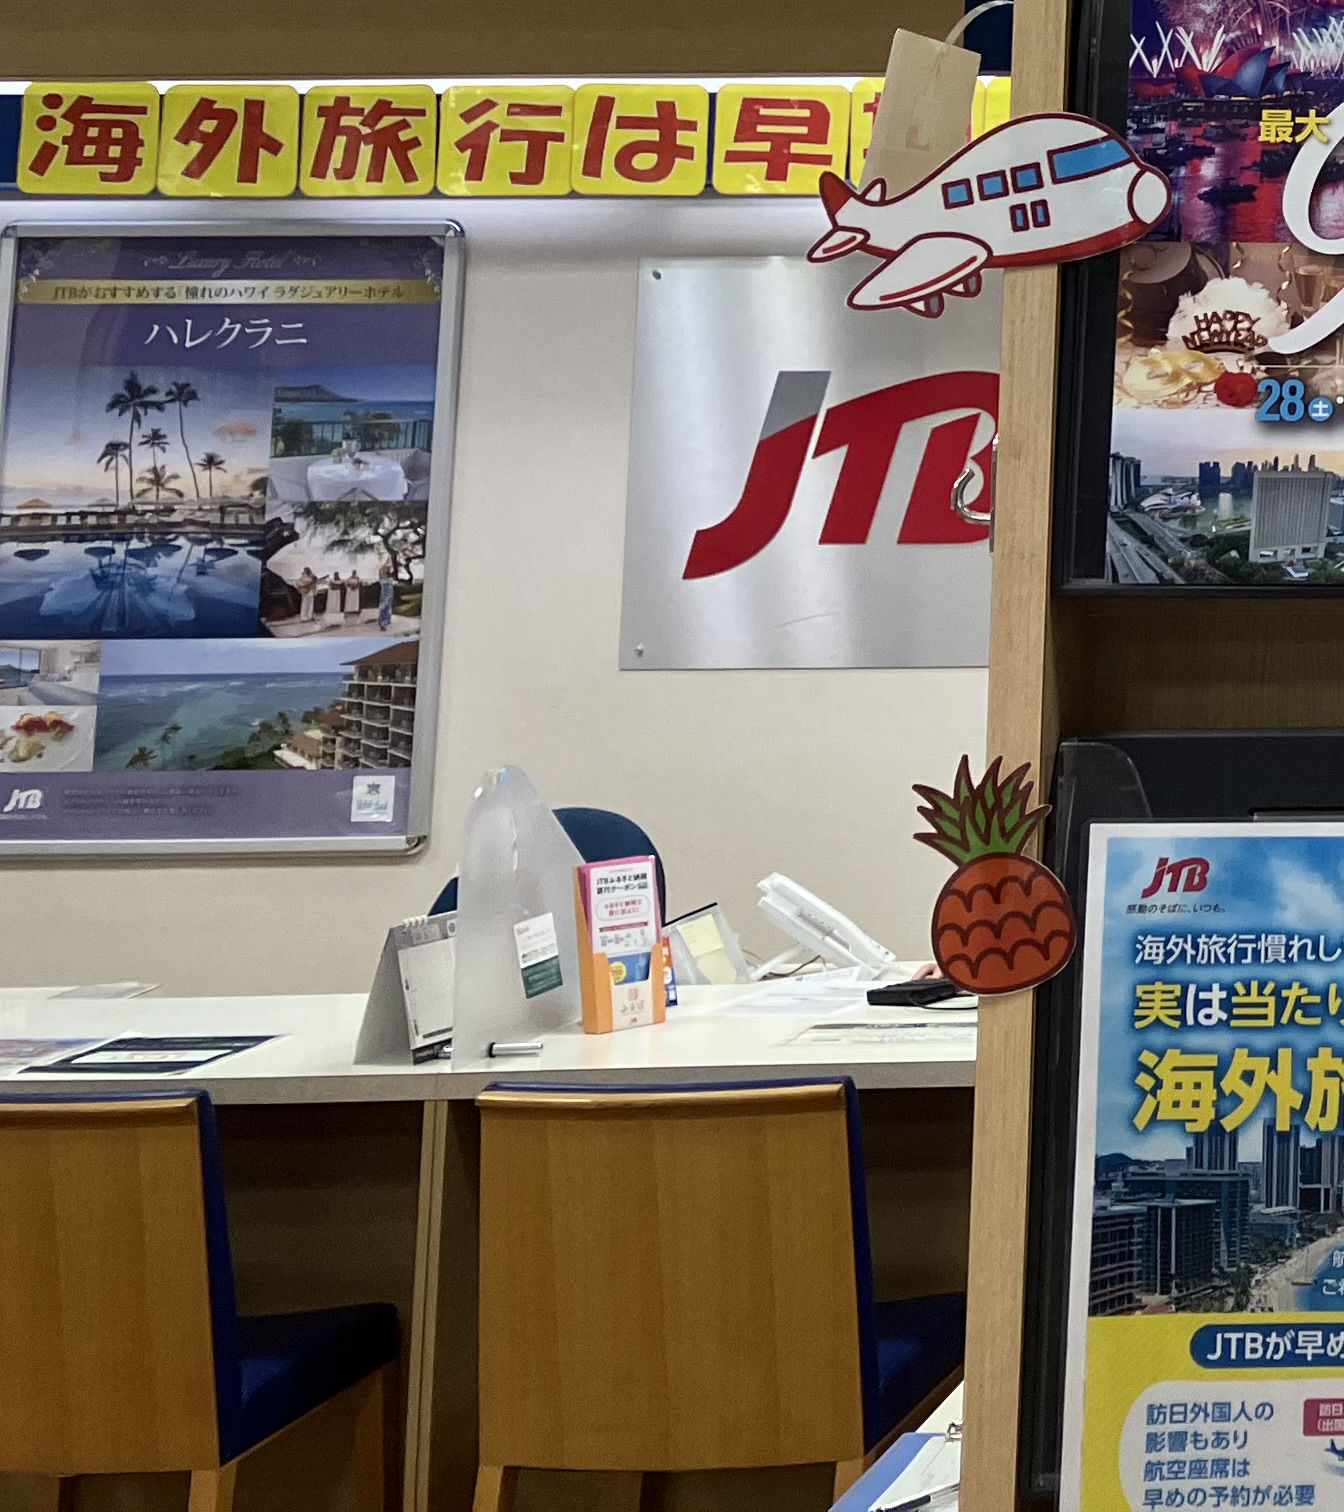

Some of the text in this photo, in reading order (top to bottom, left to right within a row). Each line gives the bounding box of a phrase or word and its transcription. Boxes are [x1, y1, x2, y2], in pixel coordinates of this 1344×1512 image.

[25, 92, 878, 186] 海外旅行は早
[1258, 109, 1330, 143] 最大
[144, 319, 307, 347] ハレクラニ
[1141, 857, 1210, 898] JTB
[1146, 1403, 1274, 1425] 訪日外国人の
[1146, 1432, 1248, 1453] 影響もあり
[1144, 1459, 1250, 1481] 航空座席は
[1142, 1484, 1316, 1509] 早めの予約が必要
